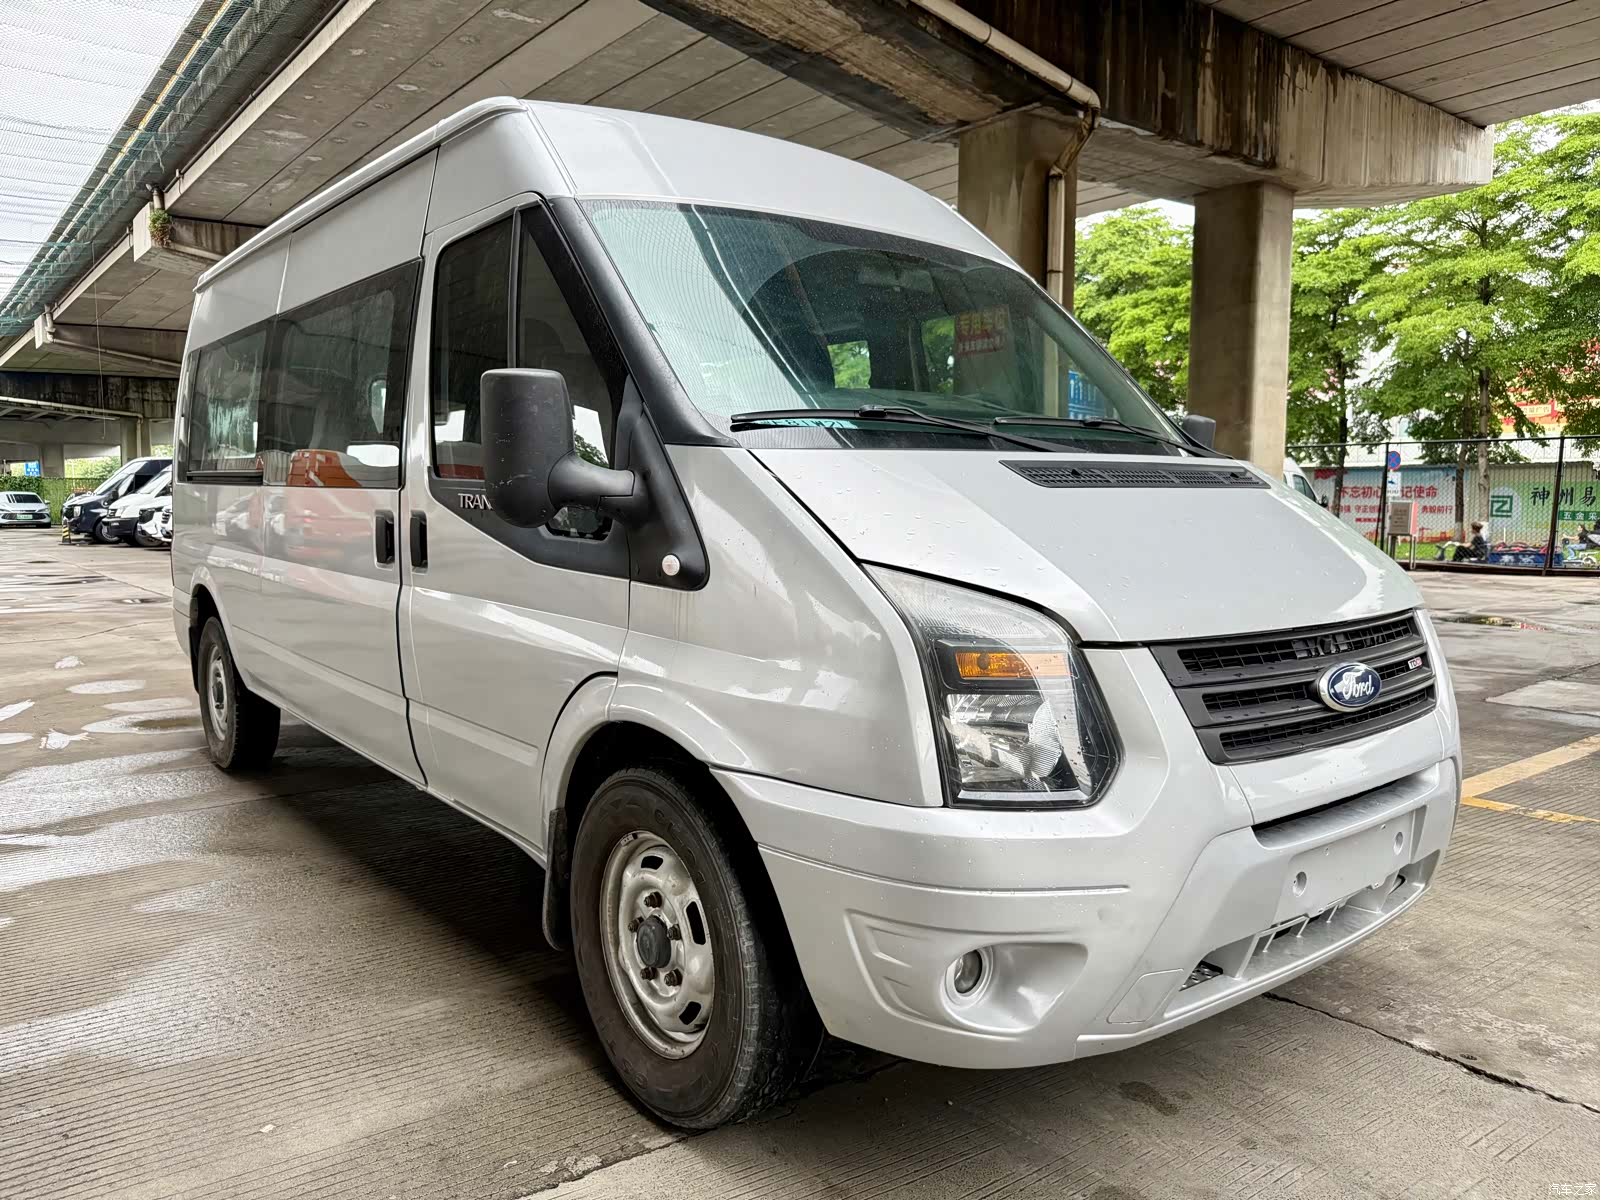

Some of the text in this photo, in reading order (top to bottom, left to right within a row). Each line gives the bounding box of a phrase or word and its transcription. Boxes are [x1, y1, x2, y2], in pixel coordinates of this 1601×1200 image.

[1400, 485, 1438, 498] 记使命
[1530, 486, 1597, 506] 神州易
[457, 493, 494, 510] TRAN
[1564, 511, 1600, 521] 五金采
[1340, 670, 1375, 700] Ford
